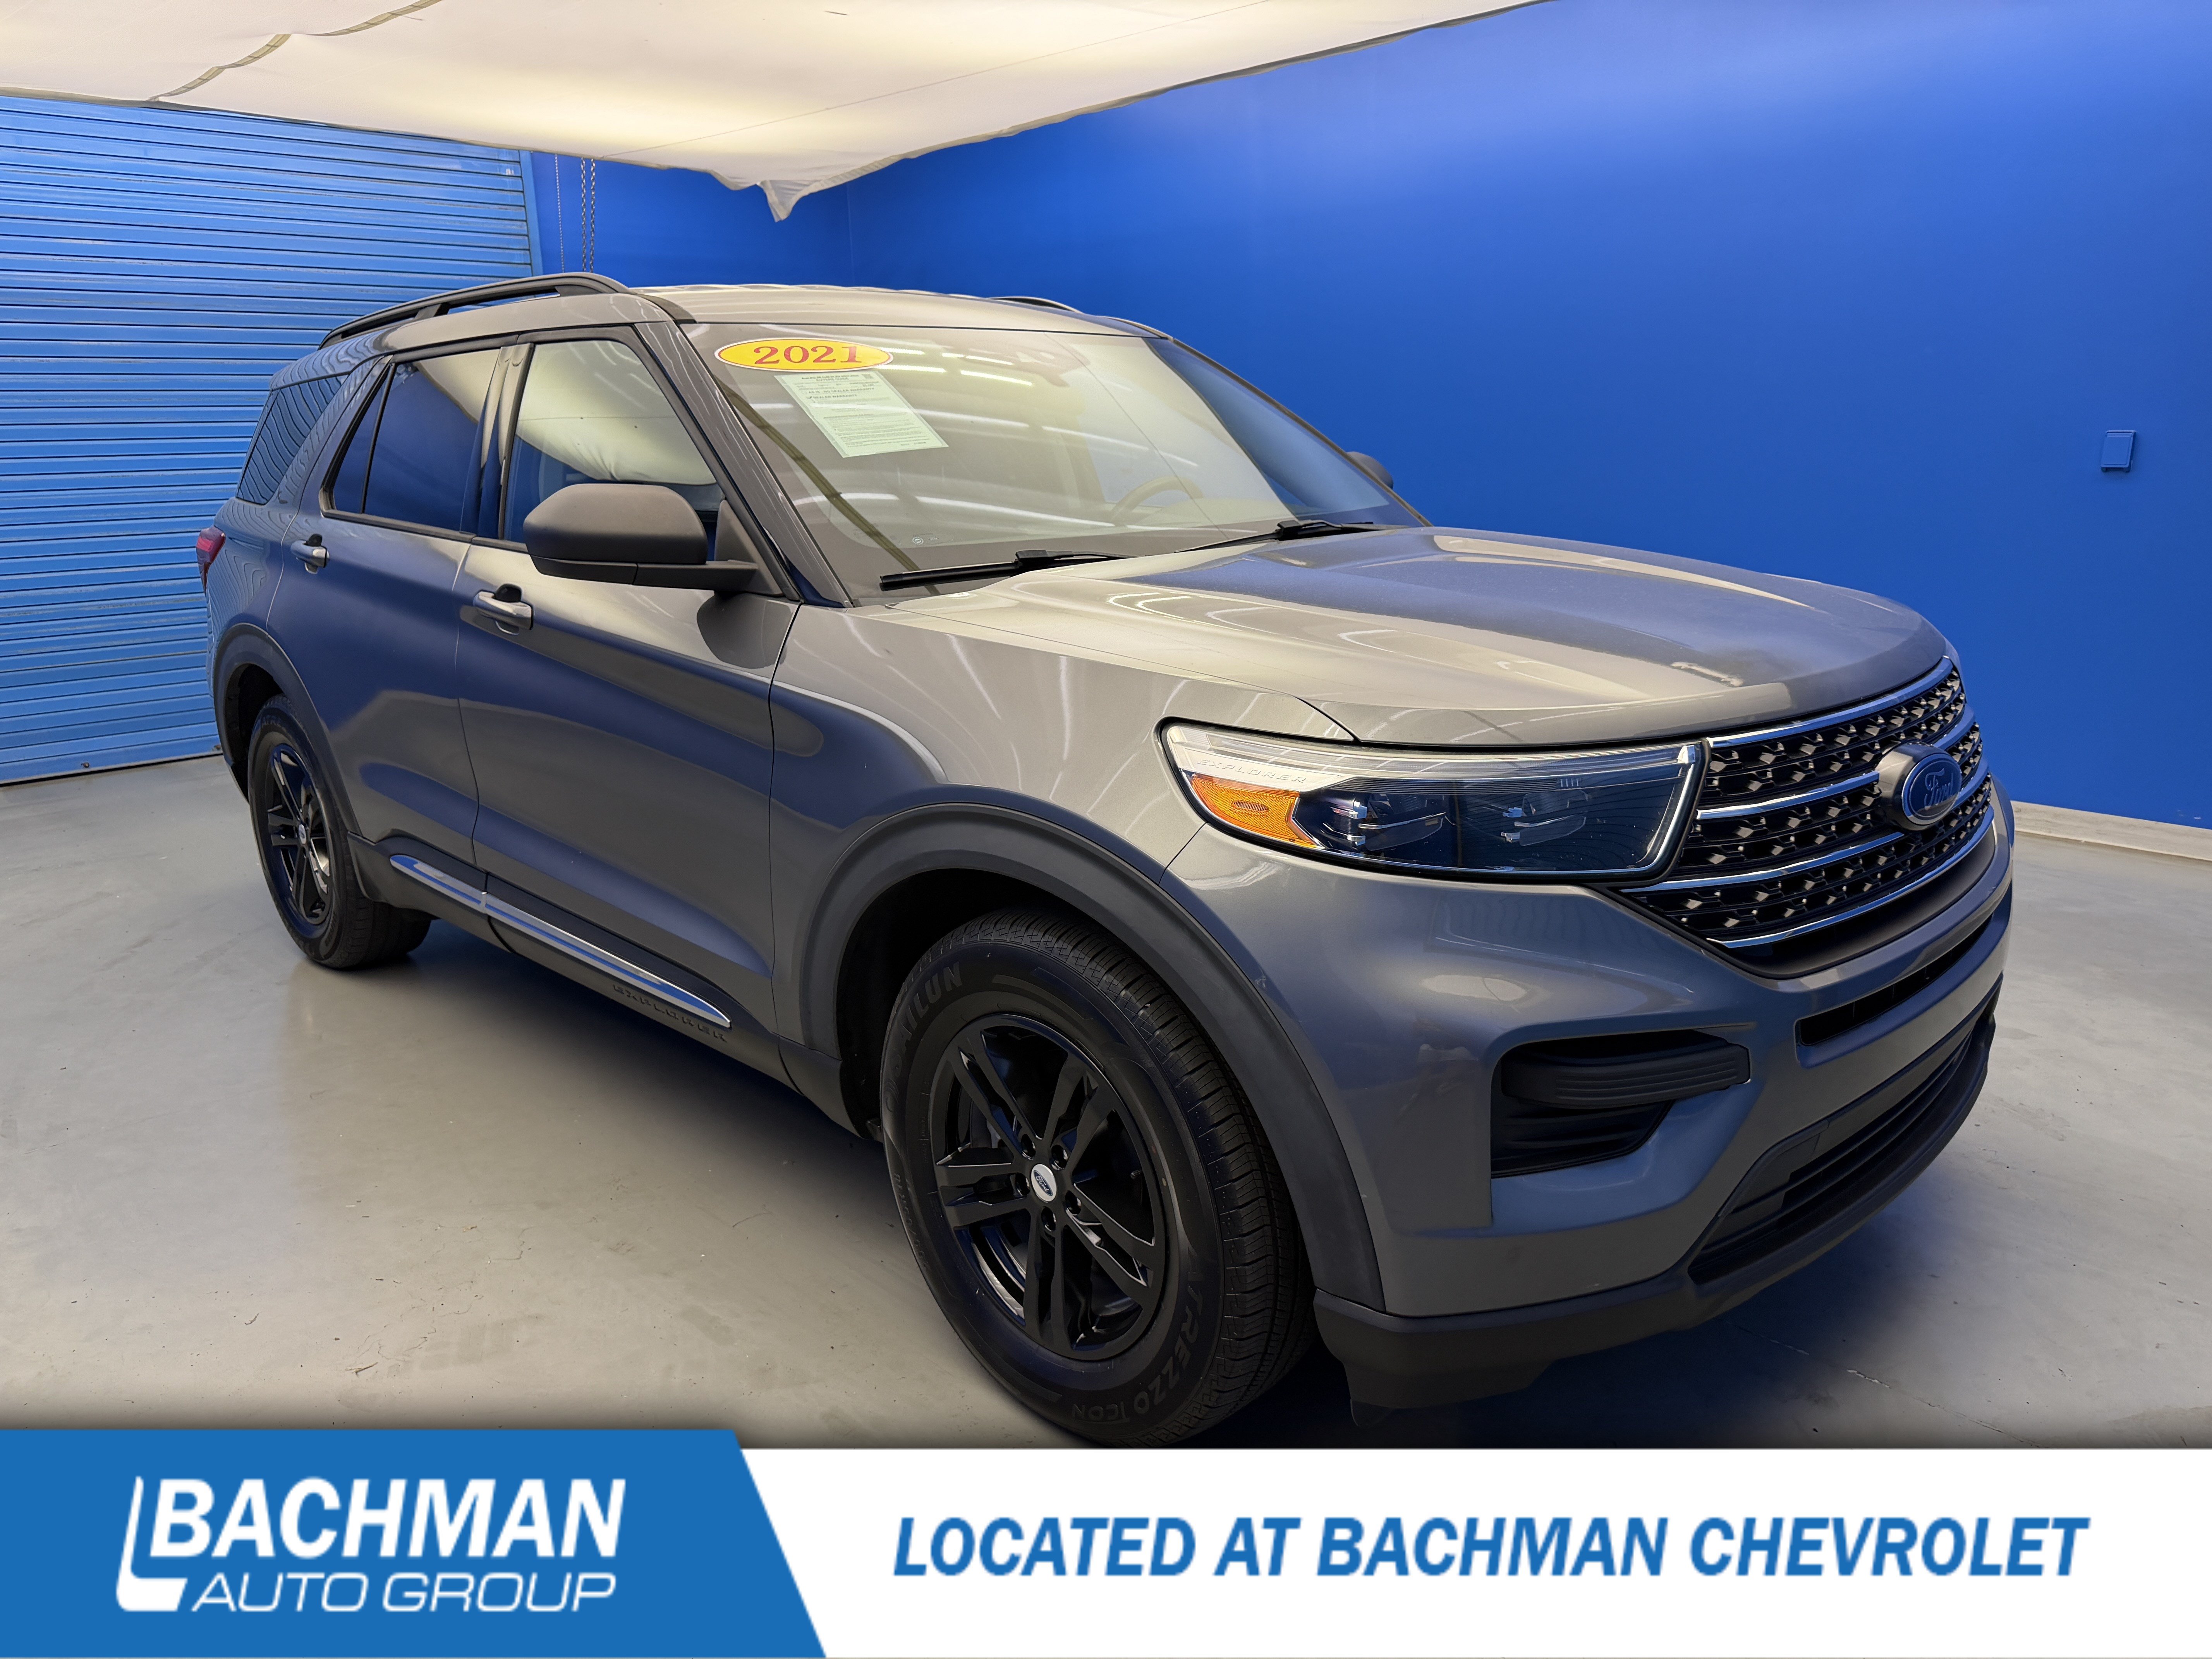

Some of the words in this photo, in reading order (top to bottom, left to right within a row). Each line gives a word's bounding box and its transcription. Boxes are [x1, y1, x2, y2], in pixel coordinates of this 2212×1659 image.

[753, 345, 862, 364] 2021
[1197, 759, 1307, 783] EXPLORER
[1924, 768, 1954, 811] Ford
[1036, 1175, 1049, 1192] Ford
